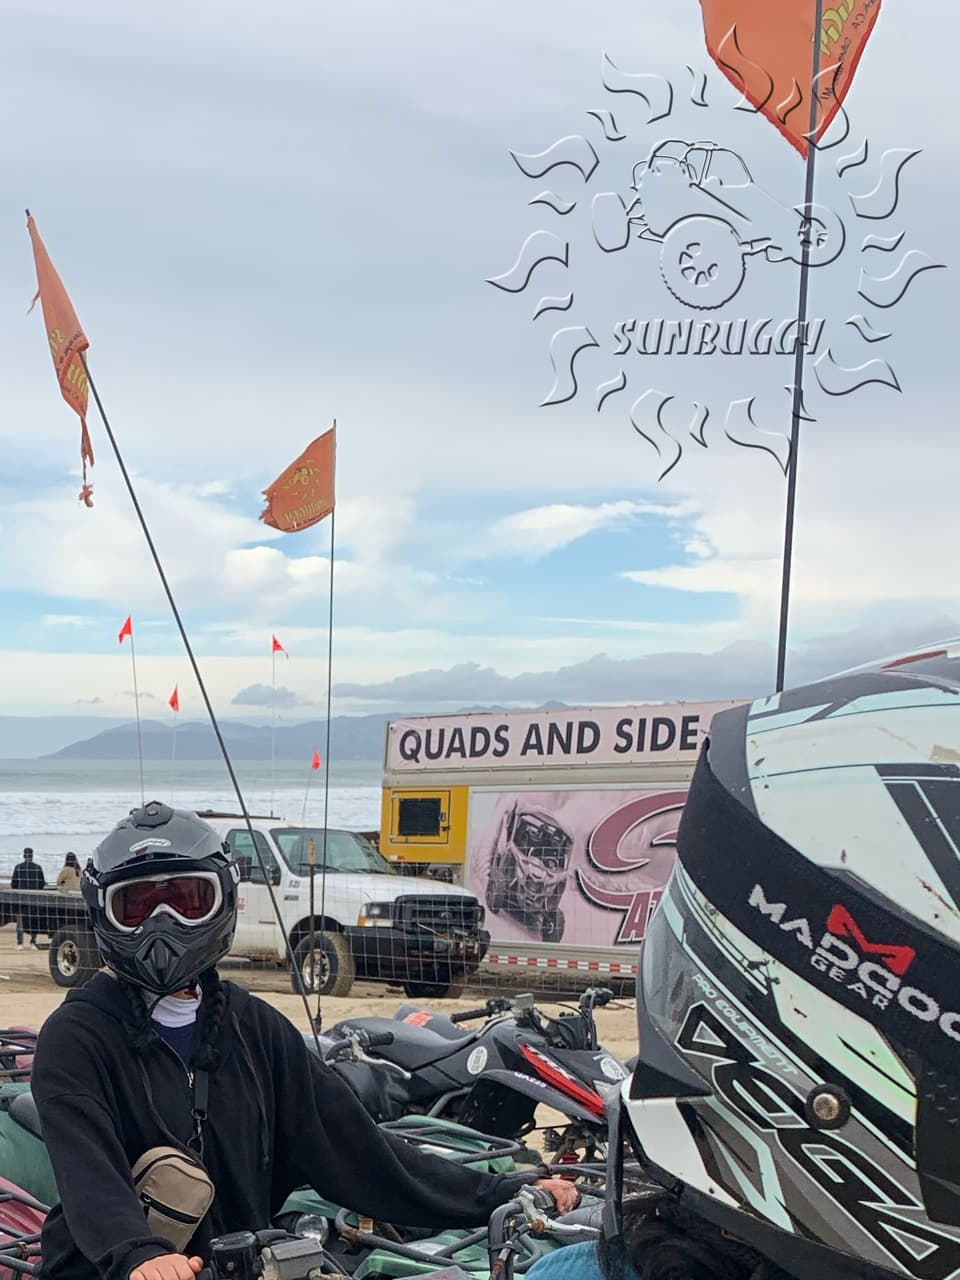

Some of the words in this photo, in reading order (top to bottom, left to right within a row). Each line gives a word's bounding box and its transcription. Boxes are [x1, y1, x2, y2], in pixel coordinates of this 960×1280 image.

[398, 724, 511, 763] QUADS
[520, 720, 601, 756] AND
[613, 715, 701, 753] SIDE
[810, 954, 890, 1010] GEAR
[692, 973, 718, 999] PRO
[715, 1000, 798, 1075] EQUIPMENT
